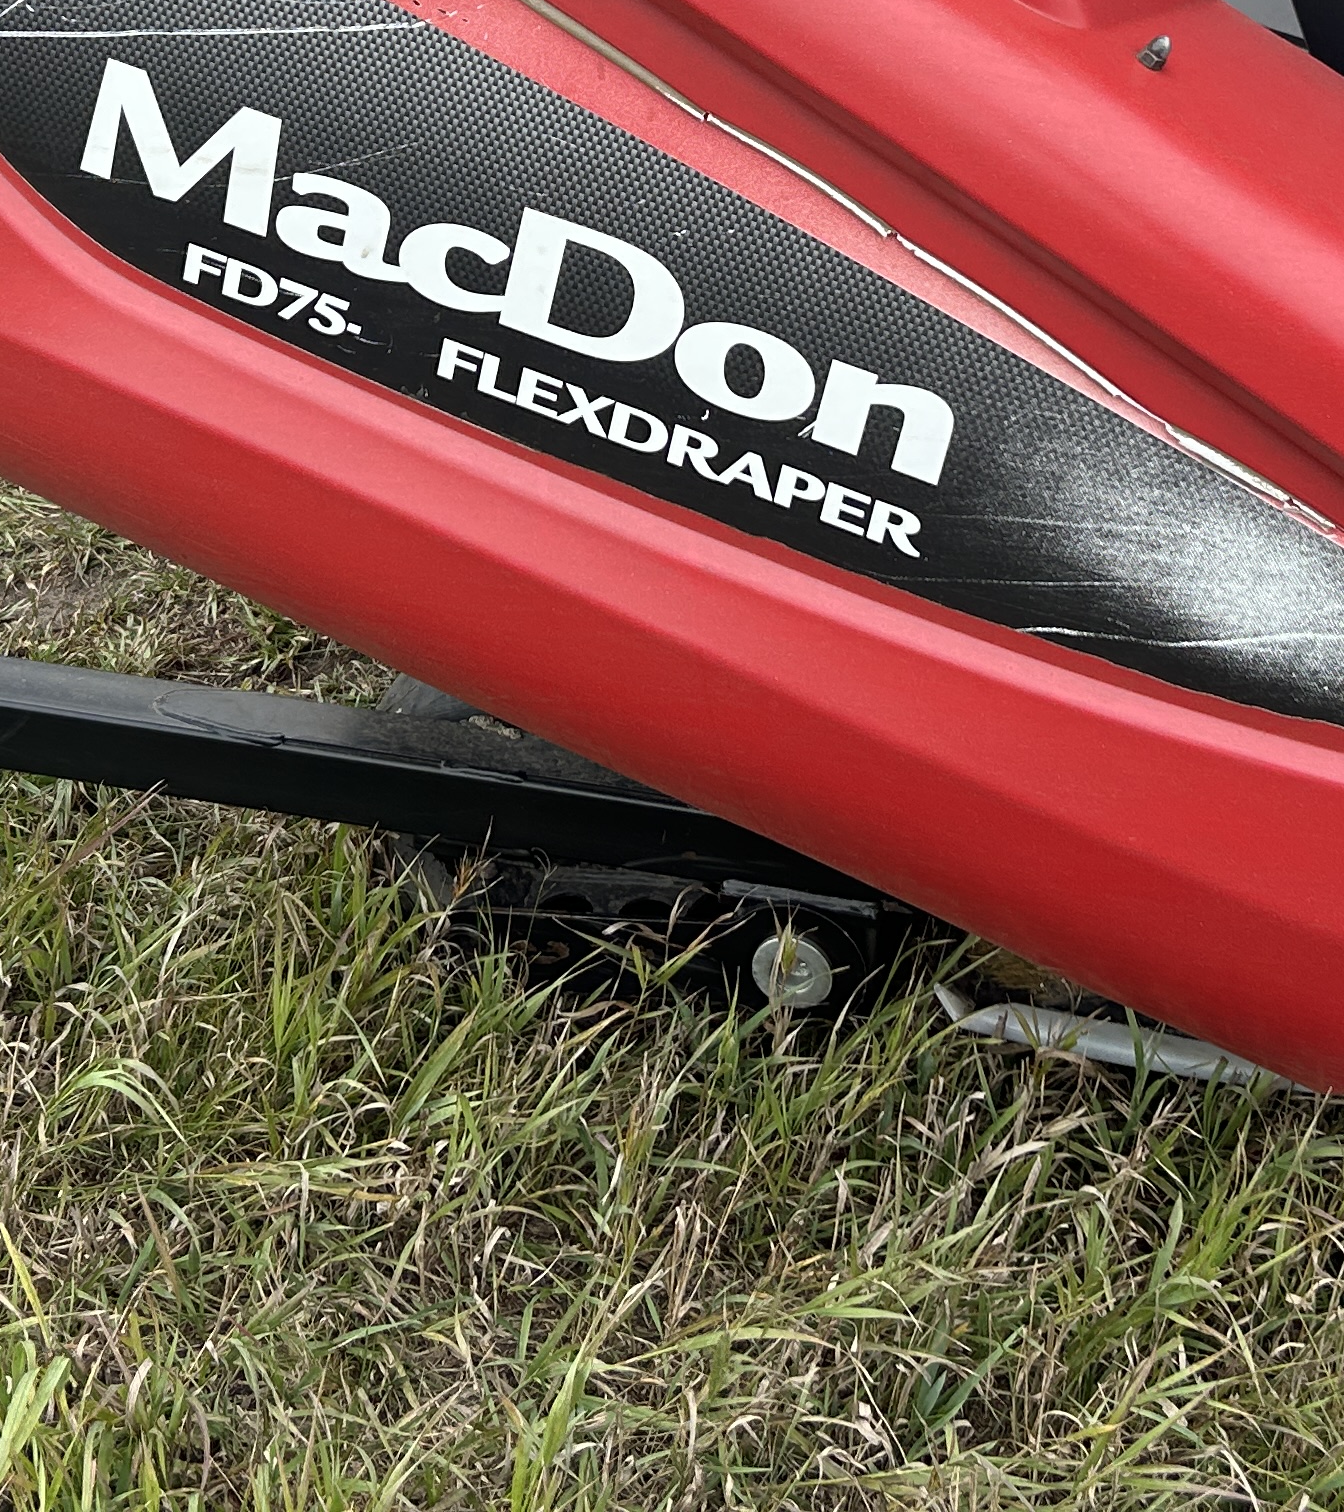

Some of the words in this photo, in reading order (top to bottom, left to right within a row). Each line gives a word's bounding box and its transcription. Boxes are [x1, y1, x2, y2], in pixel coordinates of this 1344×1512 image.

[80, 58, 954, 485] MacDon
[183, 243, 362, 335] FD75-
[437, 338, 920, 557] FLEXDRAPER
